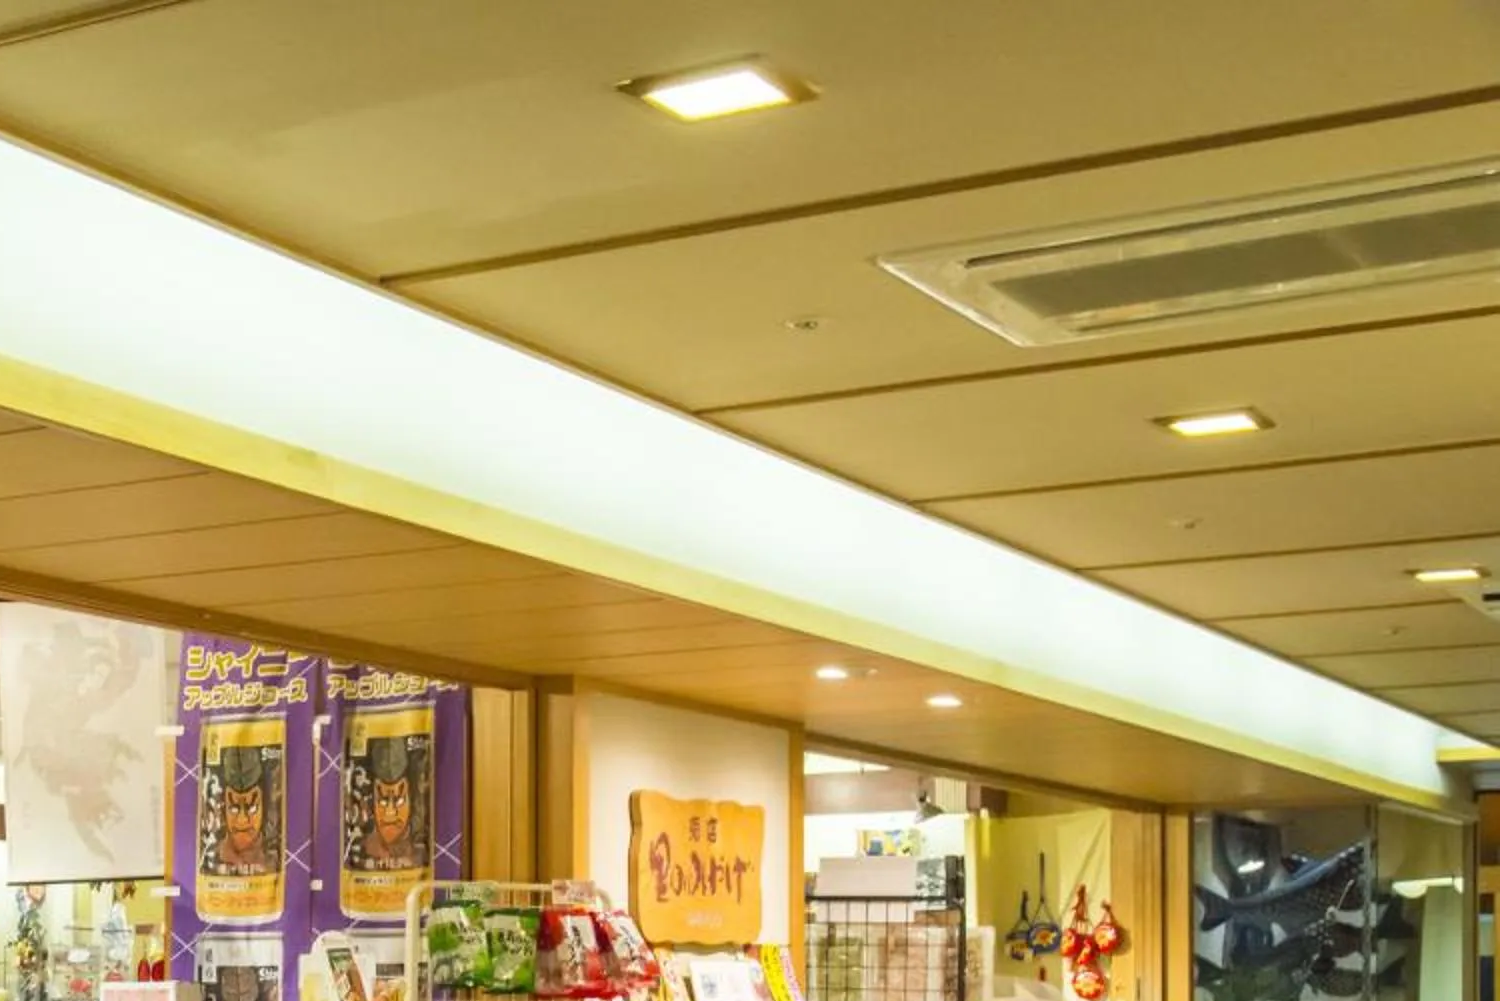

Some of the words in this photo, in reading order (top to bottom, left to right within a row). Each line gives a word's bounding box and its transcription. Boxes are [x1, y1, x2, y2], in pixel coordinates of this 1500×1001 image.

[184, 678, 308, 711] アップルジュース
